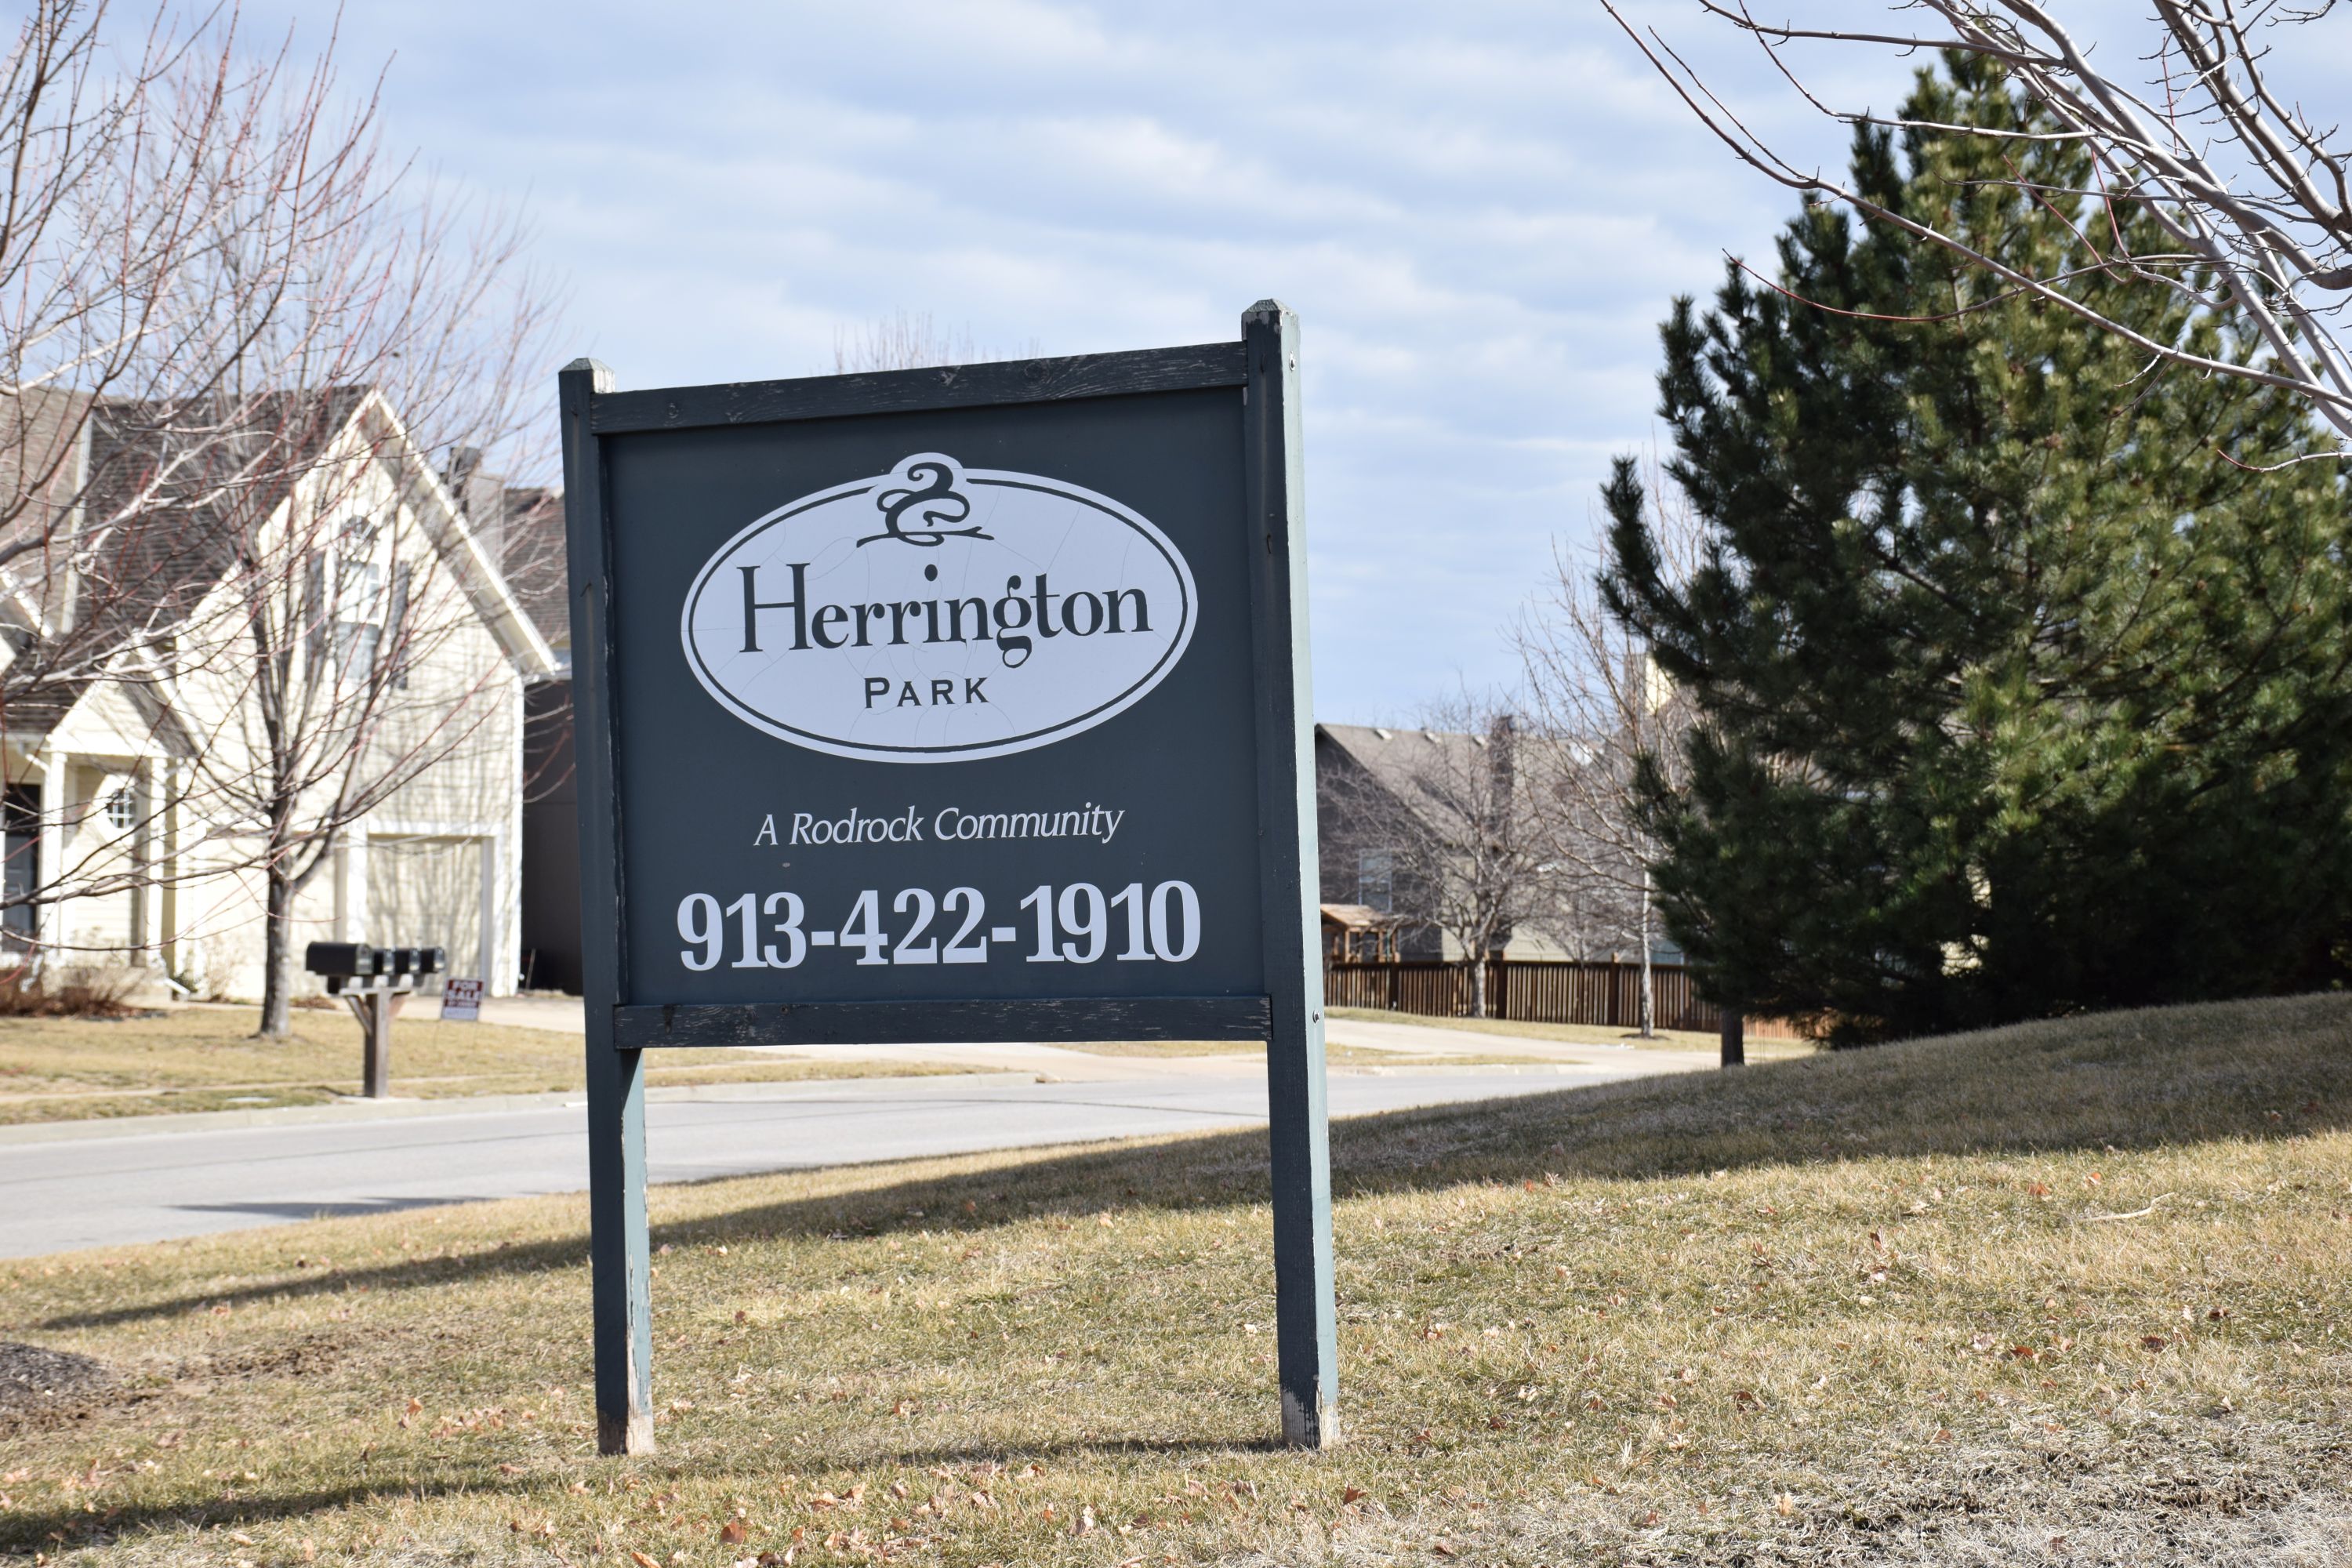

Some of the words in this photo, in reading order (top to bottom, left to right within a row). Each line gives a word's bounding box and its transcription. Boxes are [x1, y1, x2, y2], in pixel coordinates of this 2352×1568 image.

[737, 563, 1153, 668] Herrington
[865, 677, 989, 708] PARK
[753, 814, 779, 846] A
[789, 804, 925, 845] Rodrock
[935, 801, 1126, 844] Community
[677, 880, 1201, 971] 913-422-1910
[448, 989, 481, 999] SALE
[453, 981, 477, 989] FOR
